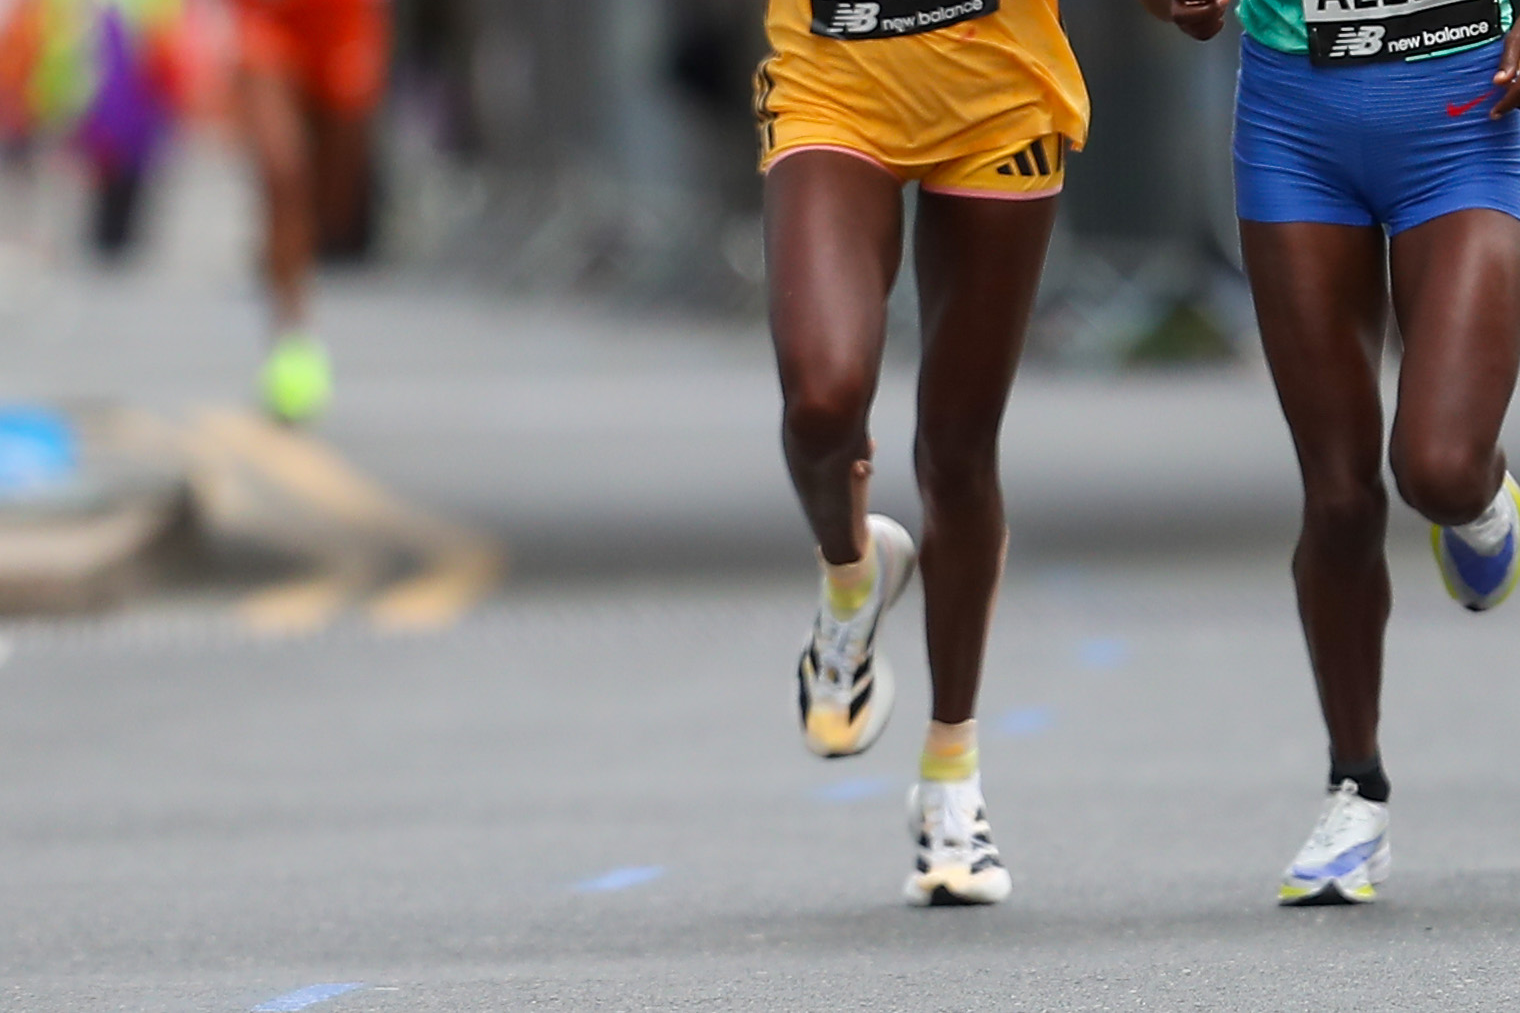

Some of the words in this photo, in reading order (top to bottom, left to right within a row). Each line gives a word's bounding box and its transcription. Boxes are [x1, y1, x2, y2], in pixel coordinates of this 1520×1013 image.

[882, 16, 915, 32] new
[1388, 34, 1421, 53] new
[1423, 21, 1489, 46] balance
